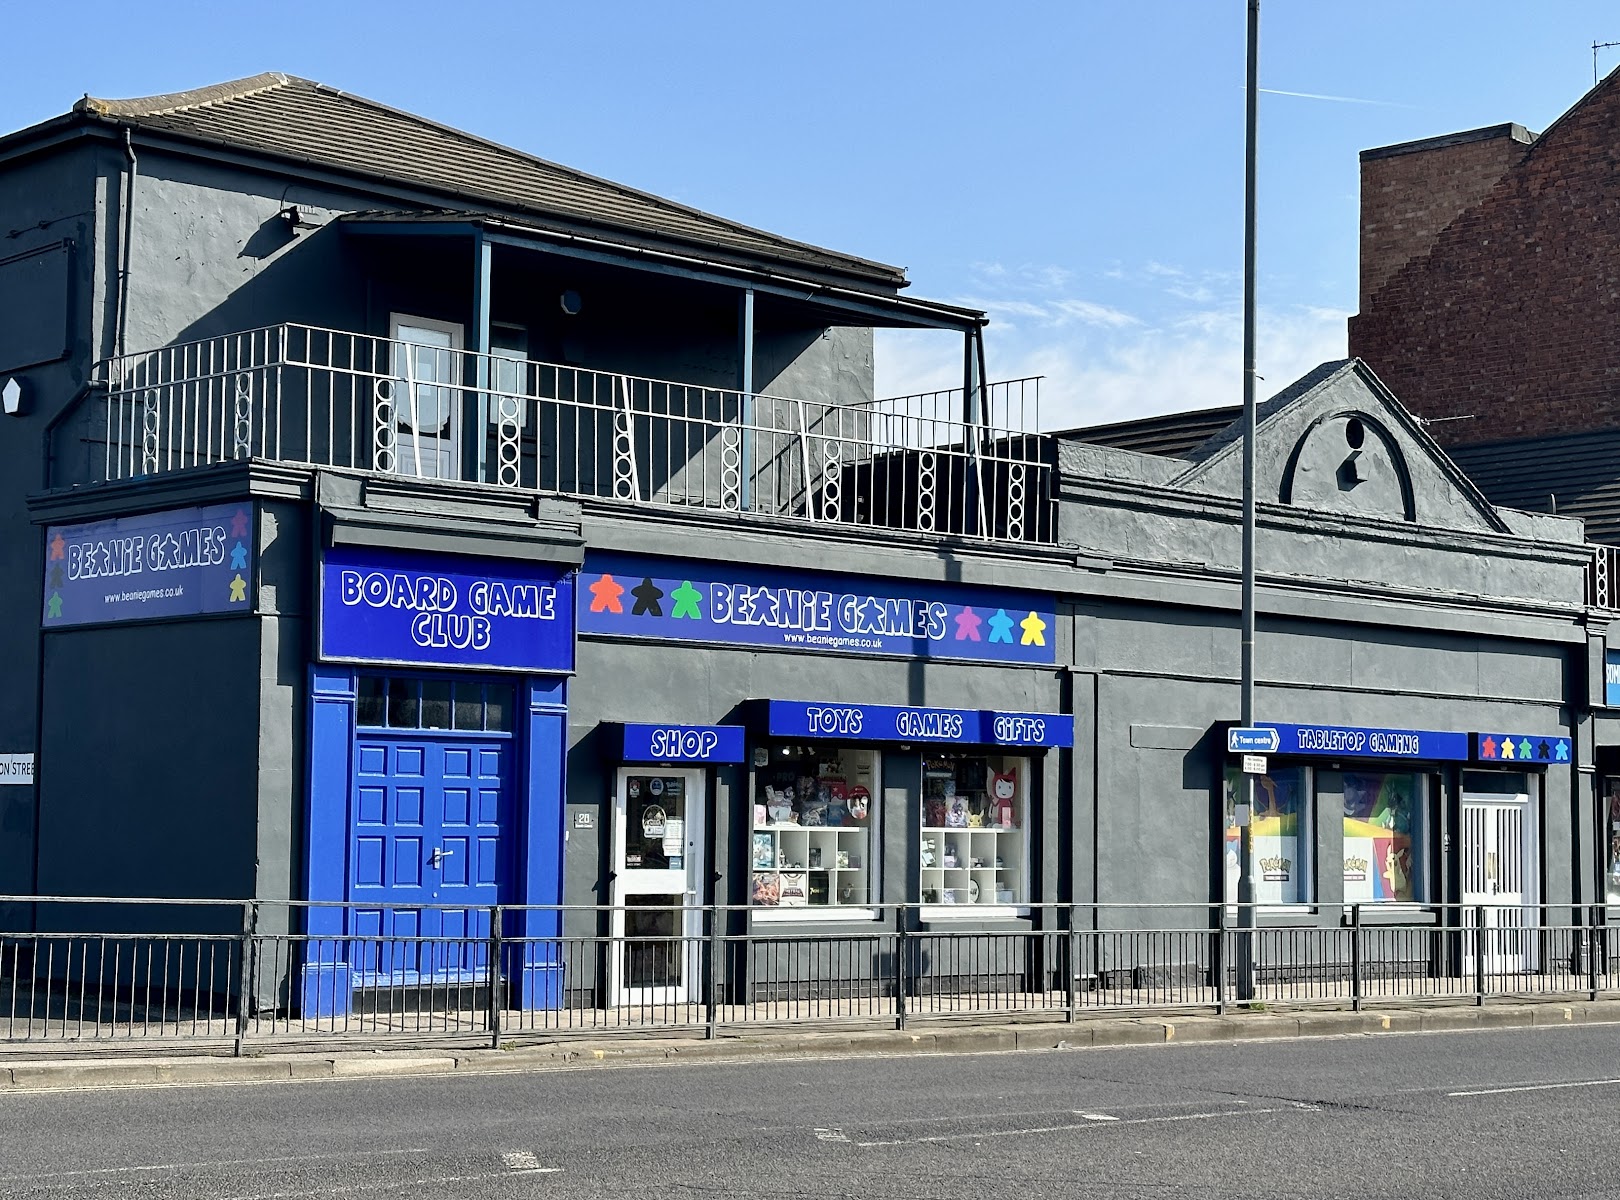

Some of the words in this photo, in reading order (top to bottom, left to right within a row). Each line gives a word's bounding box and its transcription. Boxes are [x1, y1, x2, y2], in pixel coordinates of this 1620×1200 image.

[145, 526, 227, 573] GAMES
[104, 584, 184, 604] www.beaniegames.co.uk
[341, 570, 458, 613] BOARD
[468, 581, 557, 620] GAME
[411, 612, 491, 650] CLUB
[837, 593, 948, 640] GAMES
[783, 632, 883, 649] www.beaniegames.co.uk
[806, 707, 864, 734] TOYS
[896, 711, 963, 739] GAMES
[650, 729, 718, 758] SHOP
[1239, 736, 1253, 744] Town
[1254, 736, 1271, 745] centre
[1297, 728, 1366, 751] TABLETOP
[12, 762, 35, 775] STREE
